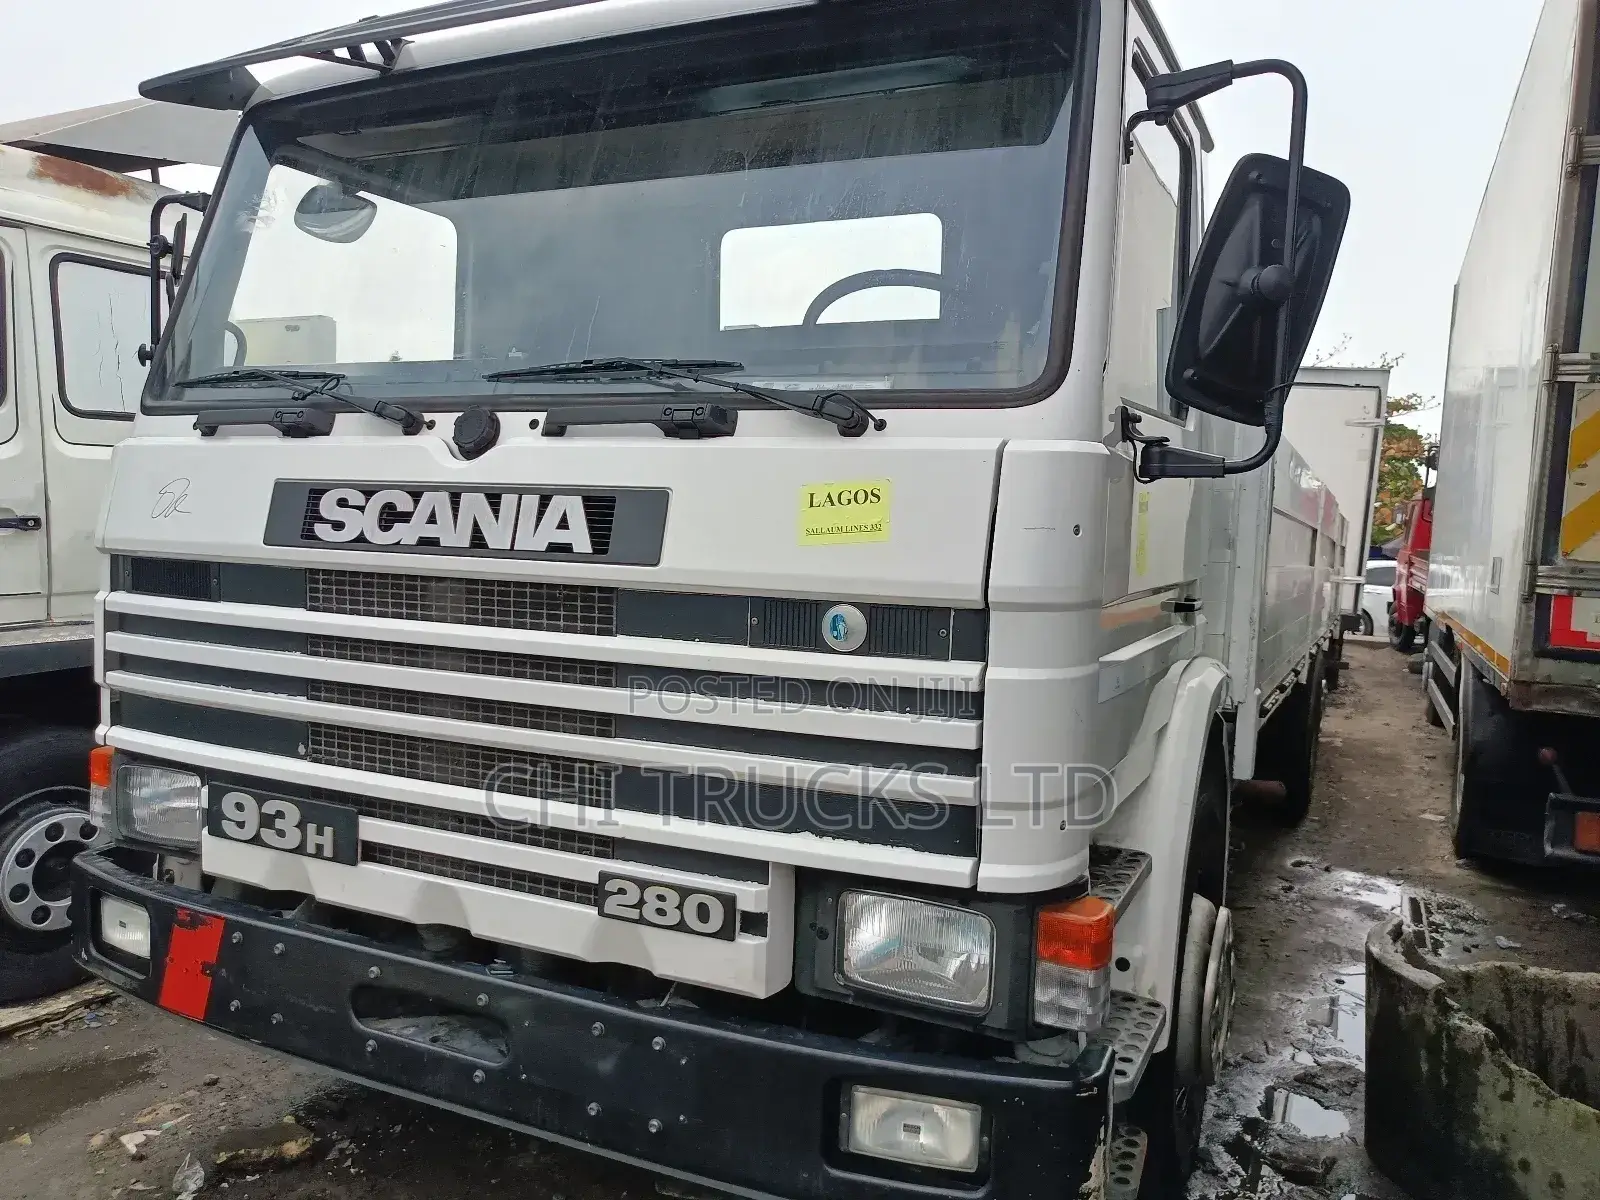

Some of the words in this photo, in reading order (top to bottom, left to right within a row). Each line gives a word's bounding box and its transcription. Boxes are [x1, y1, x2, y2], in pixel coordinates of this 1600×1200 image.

[808, 487, 881, 508] LAGOS
[314, 488, 593, 553] SCANIA
[845, 523, 868, 533] LINES
[604, 878, 725, 934] 280
